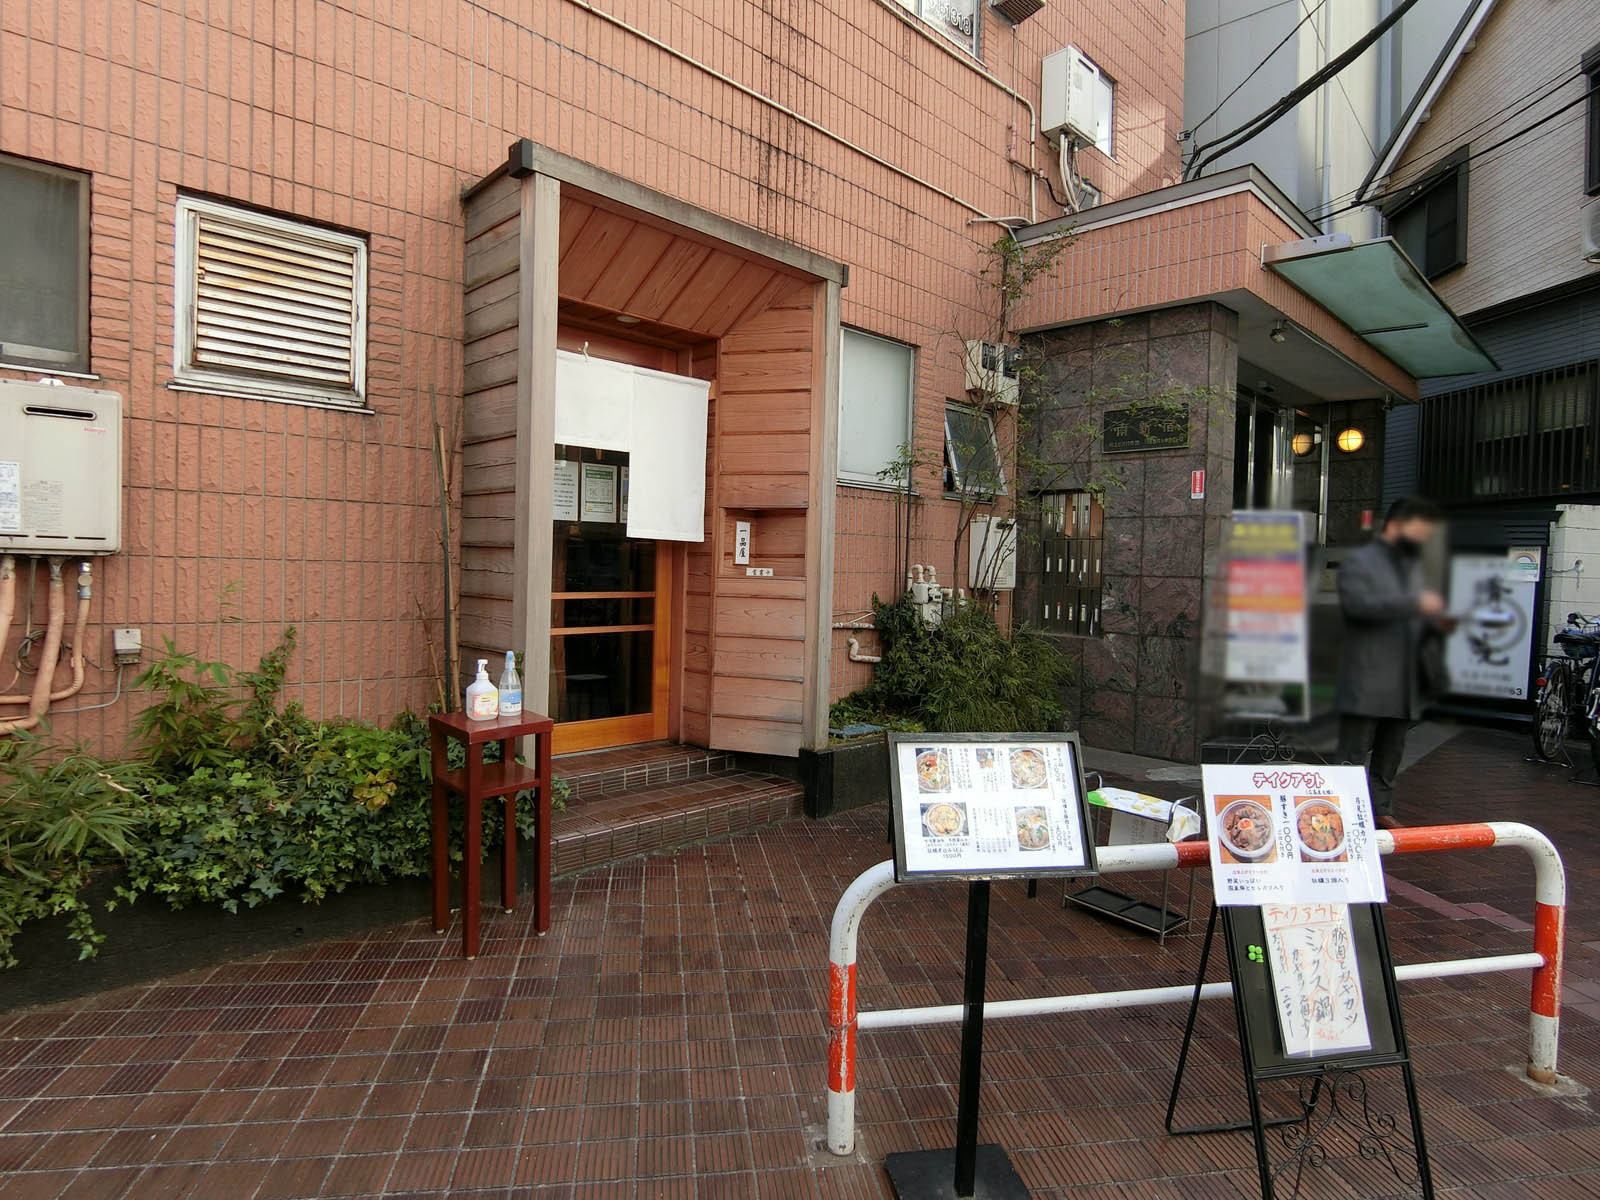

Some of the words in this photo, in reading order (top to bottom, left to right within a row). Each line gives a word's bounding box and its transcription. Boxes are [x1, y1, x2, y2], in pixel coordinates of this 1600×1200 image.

[739, 529, 747, 558] 一品屋
[1253, 772, 1325, 789] テイクアウト
